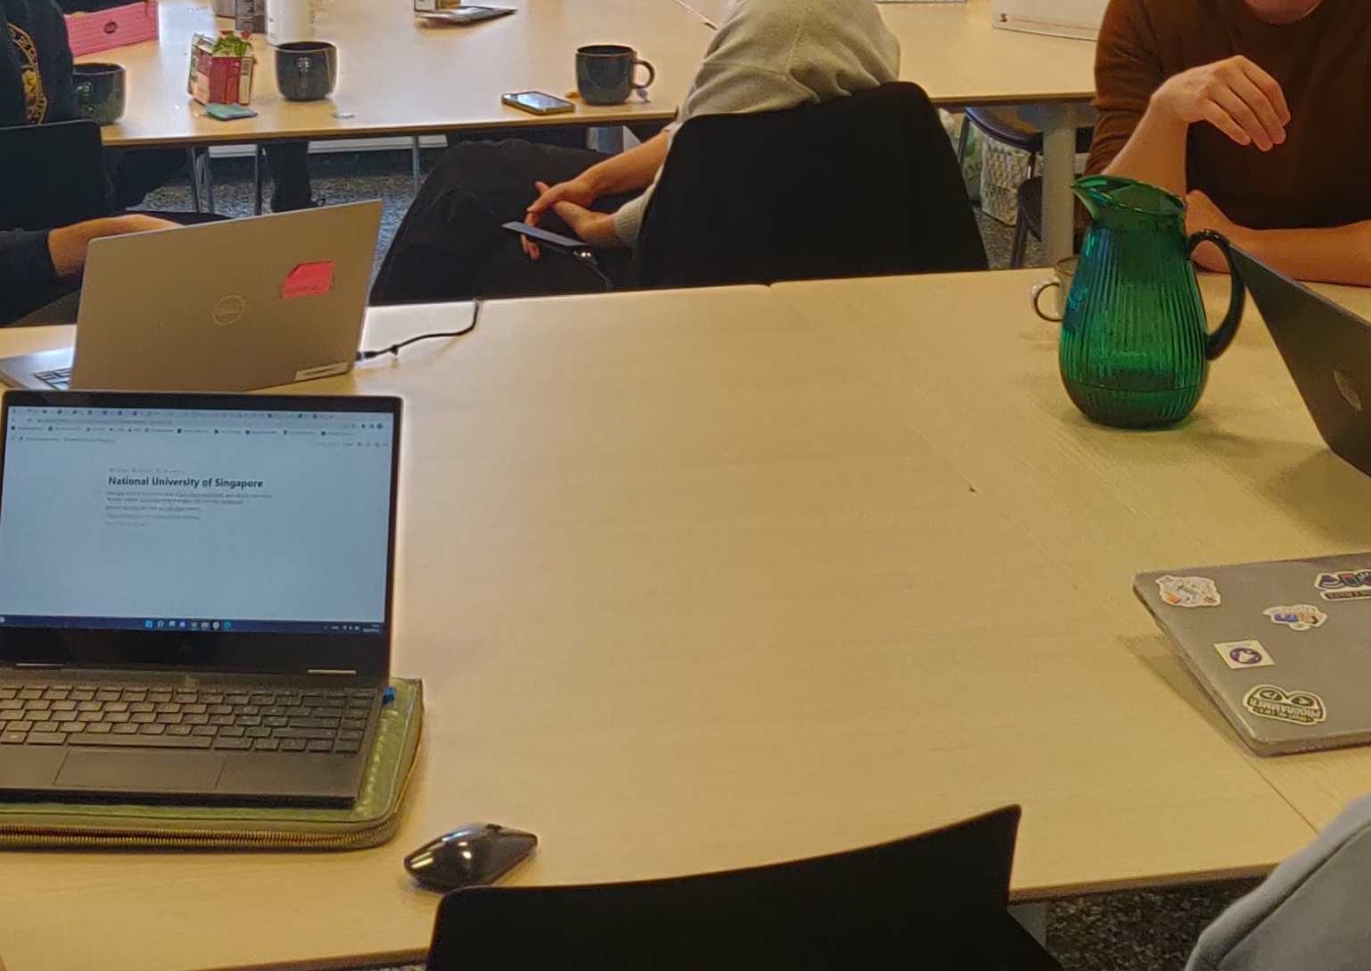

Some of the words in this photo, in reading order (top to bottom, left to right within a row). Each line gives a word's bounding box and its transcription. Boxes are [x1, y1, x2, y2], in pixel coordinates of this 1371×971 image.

[108, 476, 149, 487] National
[151, 476, 201, 490] University
[202, 477, 213, 488] of
[214, 477, 264, 491] Singapore
